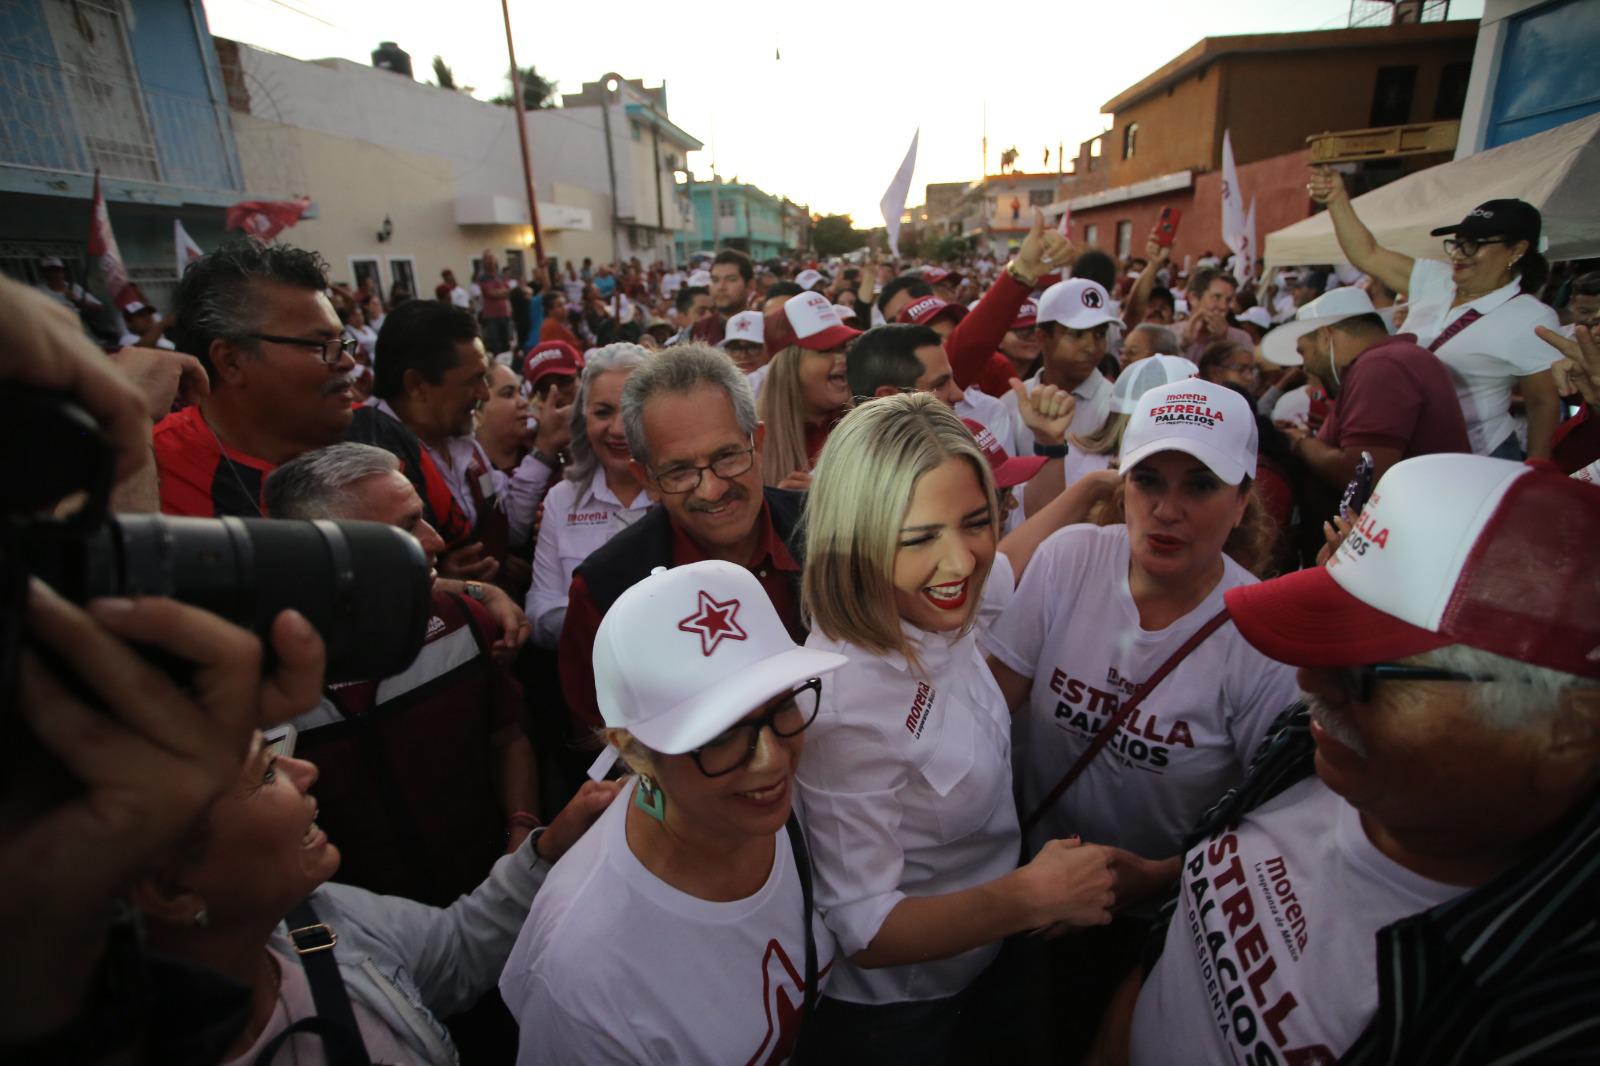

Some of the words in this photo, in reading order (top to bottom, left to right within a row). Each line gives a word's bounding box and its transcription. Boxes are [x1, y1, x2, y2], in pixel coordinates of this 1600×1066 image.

[1166, 393, 1208, 403] morena
[1149, 404, 1224, 423] ESTRELLA
[1154, 413, 1215, 427] PALACIOS
[567, 511, 608, 523] morena
[905, 681, 931, 734] morena
[1054, 700, 1170, 768] PALCIOS
[1254, 862, 1263, 874] La
[1256, 873, 1279, 917] esperanza
[1265, 856, 1309, 955] morena
[1274, 916, 1285, 929] de
[1280, 928, 1300, 963] México
[1188, 909, 1231, 1039] PRESIDENTA
